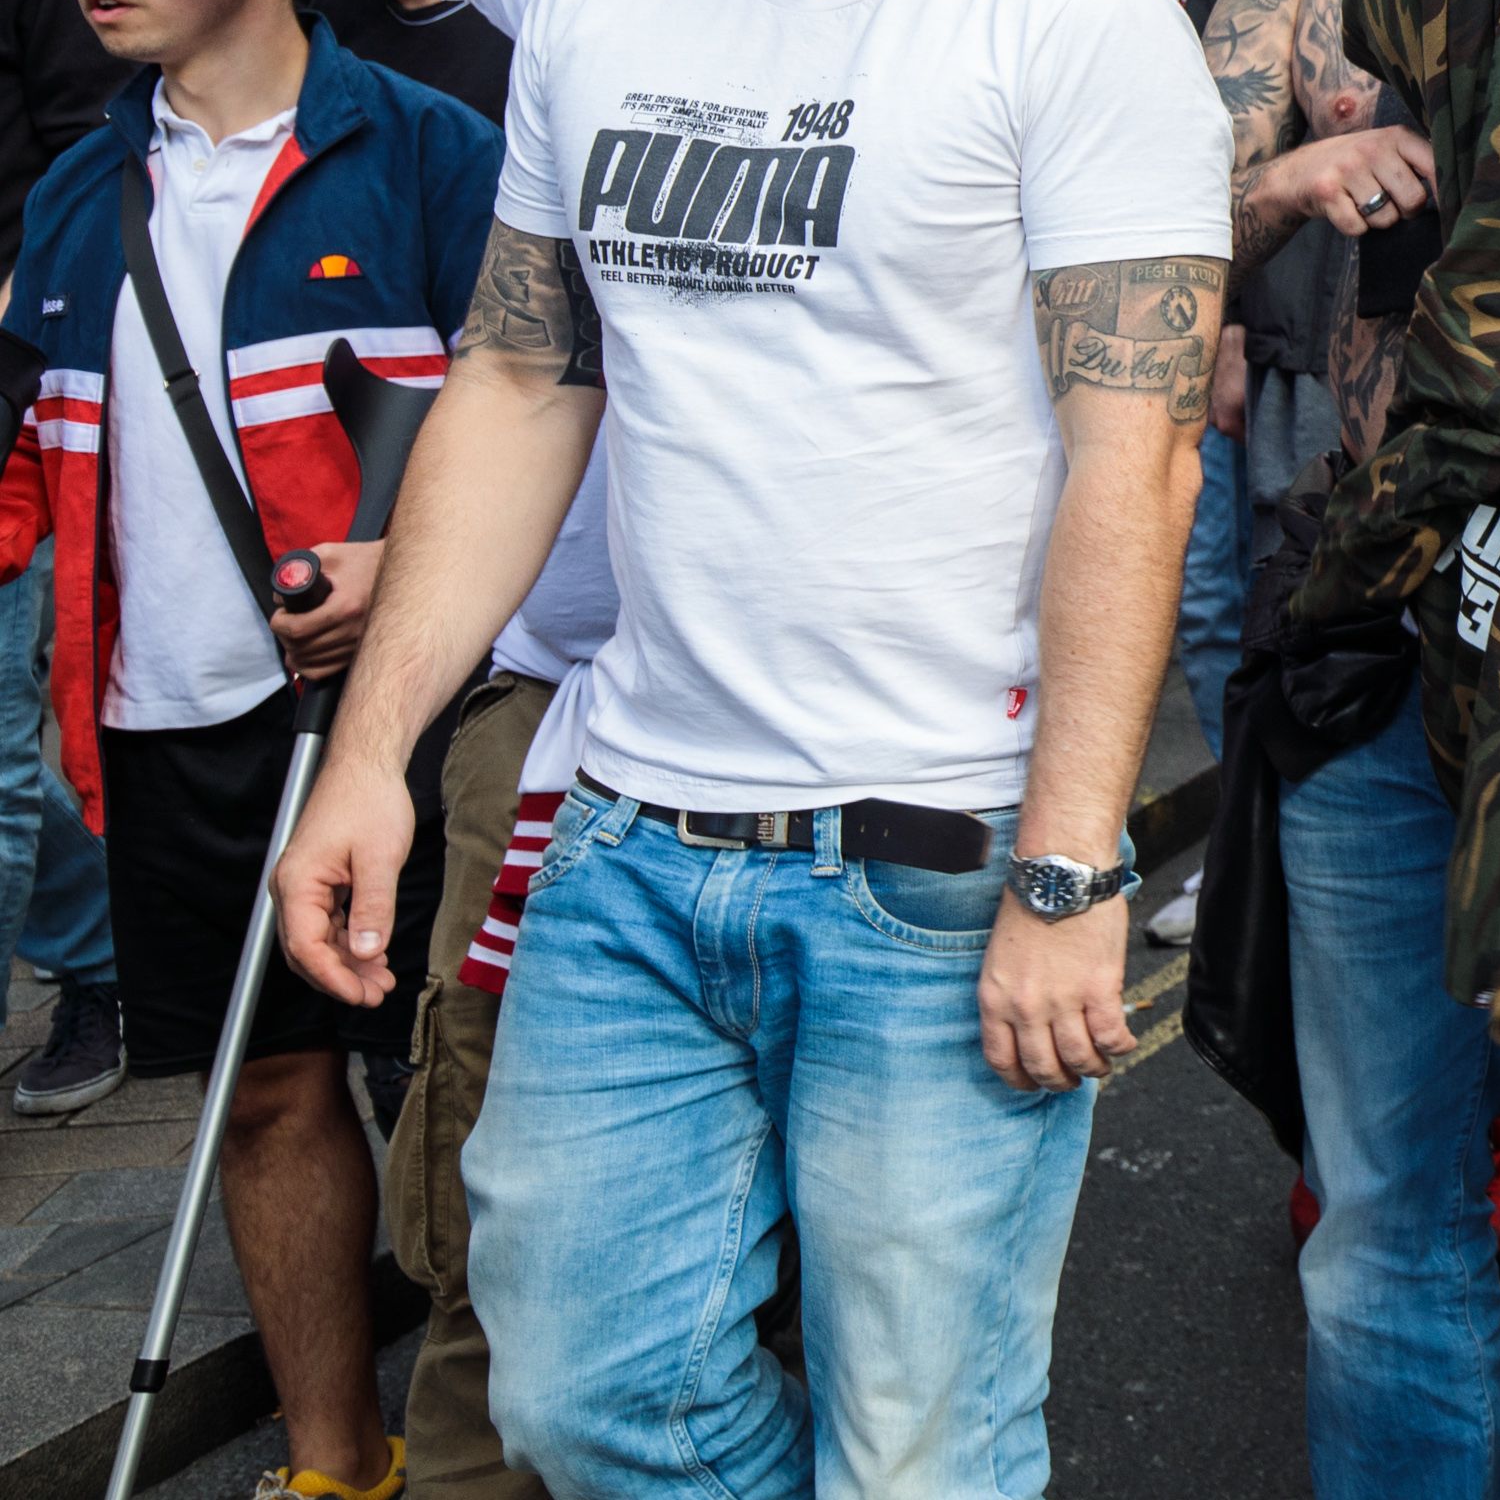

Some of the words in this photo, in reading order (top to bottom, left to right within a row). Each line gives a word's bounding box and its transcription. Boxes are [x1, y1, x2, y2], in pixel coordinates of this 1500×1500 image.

[625, 92, 654, 102] GREAT
[655, 94, 688, 106] DESIGN
[689, 99, 699, 109] IS
[702, 101, 720, 112] FOR
[638, 102, 669, 114] PRETTY
[736, 116, 768, 130] REALLY
[781, 99, 854, 142] 1948
[579, 128, 855, 248] PUMA
[589, 239, 692, 273] ATHLETIC
[699, 247, 820, 280] PRODUCT
[601, 269, 624, 283] FEEL
[627, 272, 665, 287] BETTER
[706, 280, 753, 294] LOOKING
[756, 282, 796, 295] BETTER
